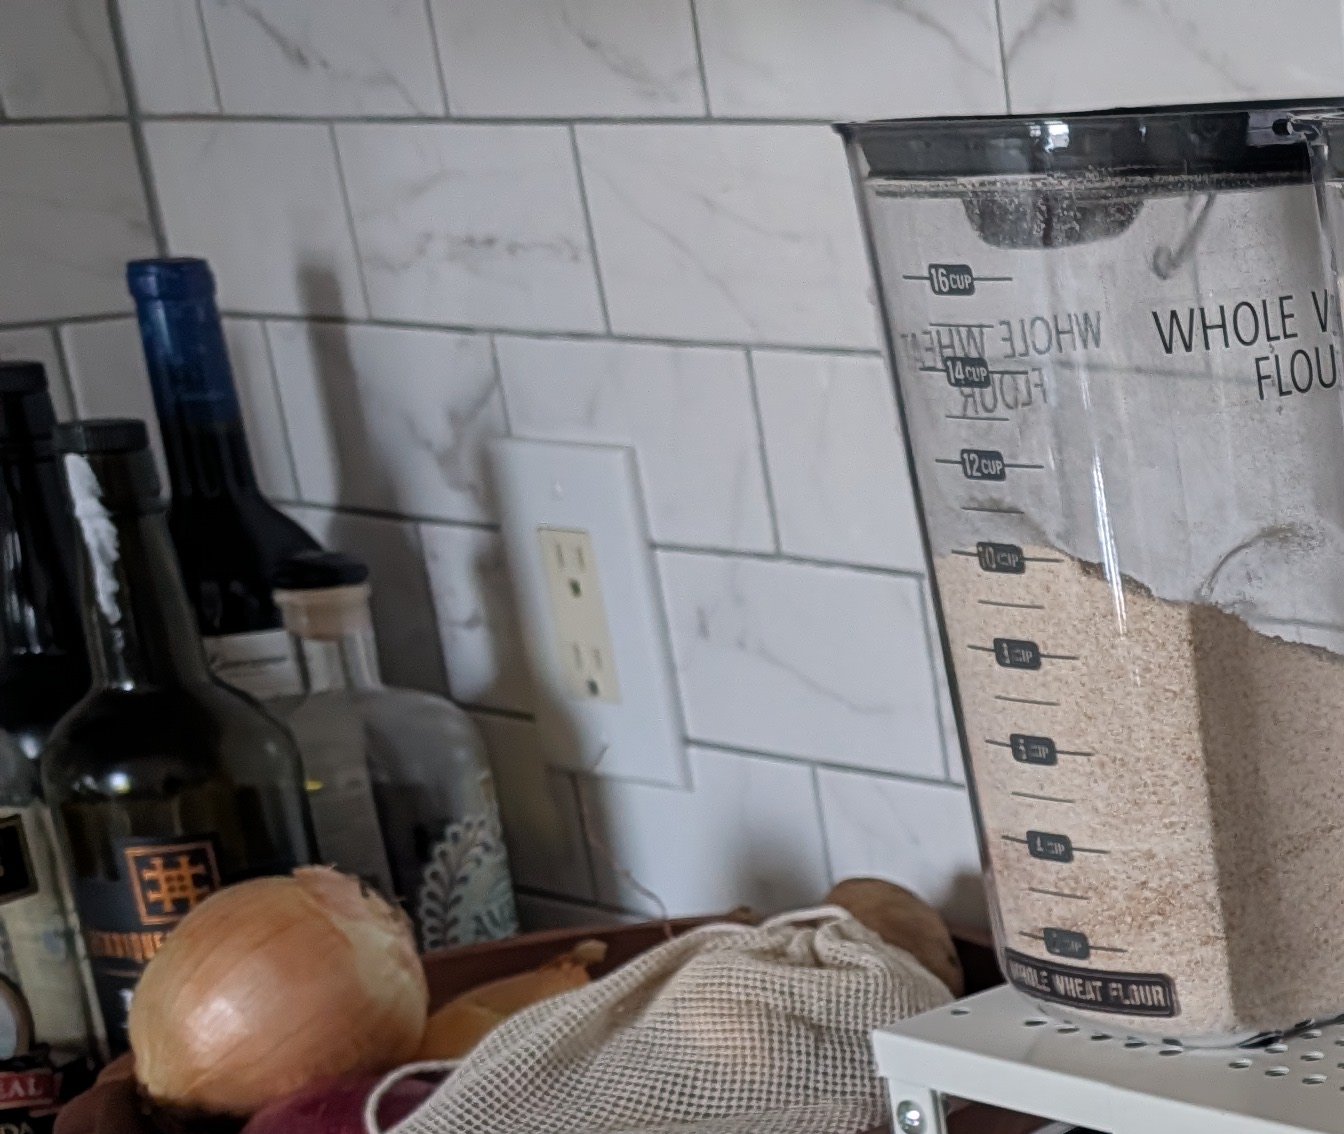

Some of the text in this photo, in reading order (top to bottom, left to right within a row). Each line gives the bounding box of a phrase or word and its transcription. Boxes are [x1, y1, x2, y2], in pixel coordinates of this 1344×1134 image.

[1152, 295, 1298, 354] WHOLE
[1255, 344, 1336, 400] FLOU
[1054, 974, 1102, 1001] WHEAT
[1108, 982, 1166, 1007] FLOUR
